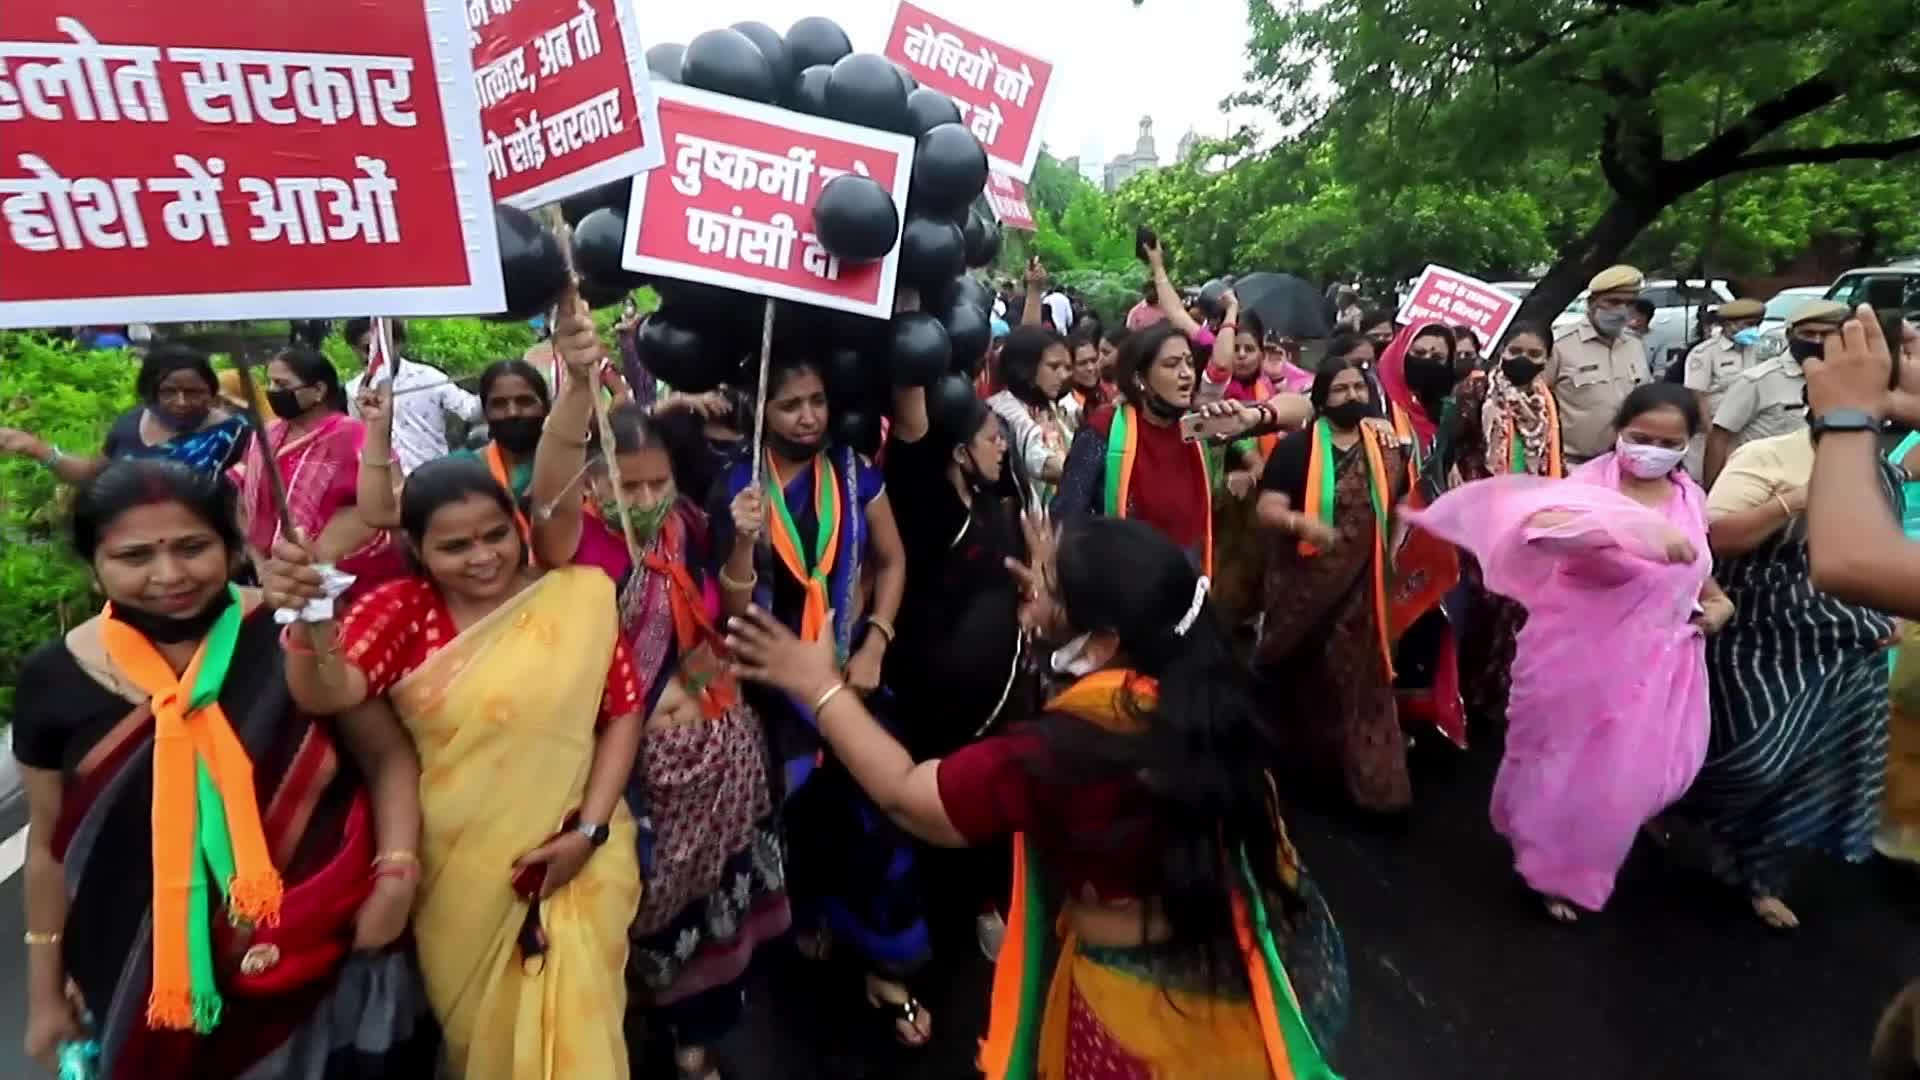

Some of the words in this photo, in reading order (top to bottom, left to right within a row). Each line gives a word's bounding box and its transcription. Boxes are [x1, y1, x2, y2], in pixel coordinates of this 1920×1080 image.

[167, 47, 417, 127] सरकार
[472, 46, 536, 109] ात्कार,
[534, 22, 574, 77] अब
[569, 0, 600, 61] तो
[903, 23, 999, 91] दोषियों
[992, 63, 1034, 107] को
[484, 129, 508, 181] गो
[503, 108, 546, 173] सोई
[542, 87, 624, 158] सरकार
[671, 132, 817, 205] दुष्कर्मी
[0, 154, 148, 251] होश
[149, 154, 231, 247] में
[685, 206, 798, 270] फांसी
[801, 231, 841, 281] द
